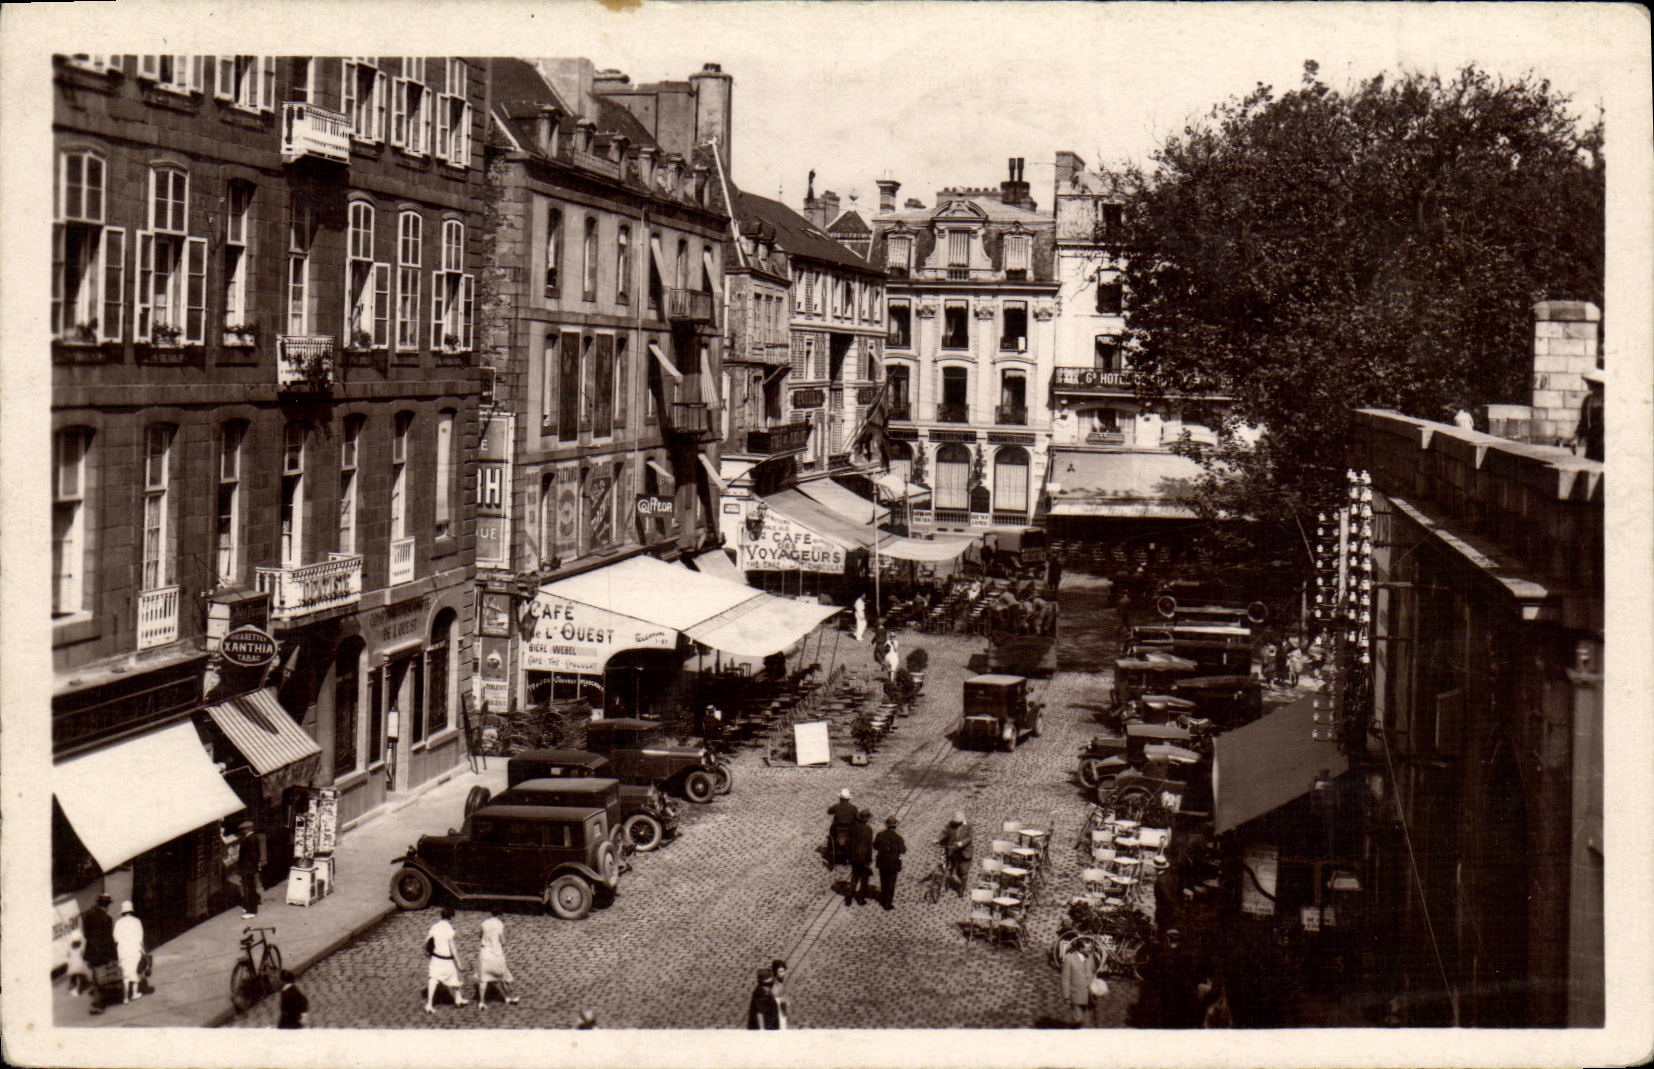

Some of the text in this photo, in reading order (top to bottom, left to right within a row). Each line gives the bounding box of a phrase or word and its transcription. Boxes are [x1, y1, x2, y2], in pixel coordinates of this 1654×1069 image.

[637, 496, 673, 514] COIFFEUR
[772, 532, 812, 545] CAFÉ
[777, 542, 796, 550] DES
[745, 544, 841, 564] VOYAGEURS
[529, 601, 575, 621] CAFÉ
[224, 641, 273, 654] XANTHIA
[237, 654, 261, 662] TABAC
